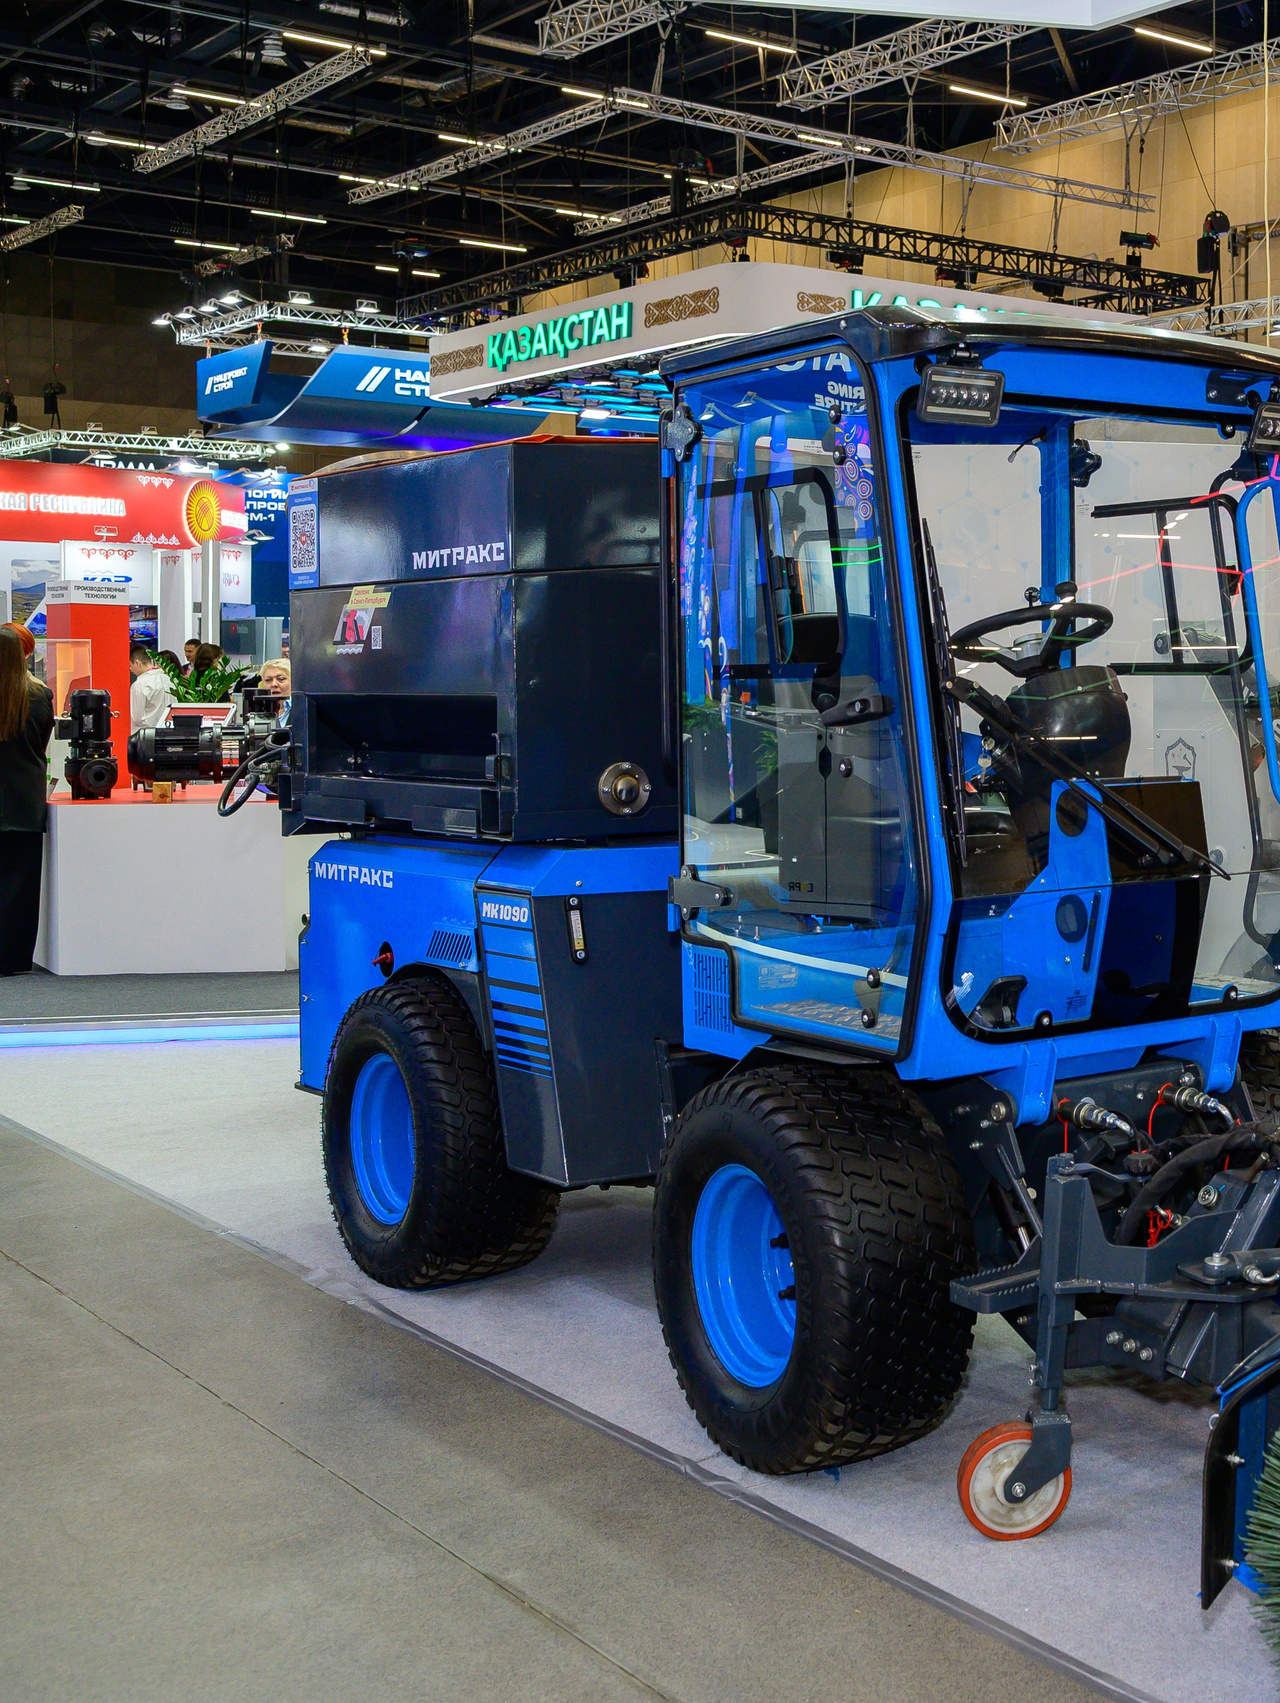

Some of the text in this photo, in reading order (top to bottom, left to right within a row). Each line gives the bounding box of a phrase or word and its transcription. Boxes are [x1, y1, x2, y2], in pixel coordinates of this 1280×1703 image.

[488, 301, 633, 372] ҚАЗАҚСТАН
[412, 542, 504, 570] МИТРАКС
[74, 585, 126, 594] ПРОИЗВОДСТВЕННЫЕ
[84, 592, 116, 600] ТЕХНОЛОГИИ
[315, 861, 394, 889] МИТРАКС
[482, 902, 530, 924] МК1090
